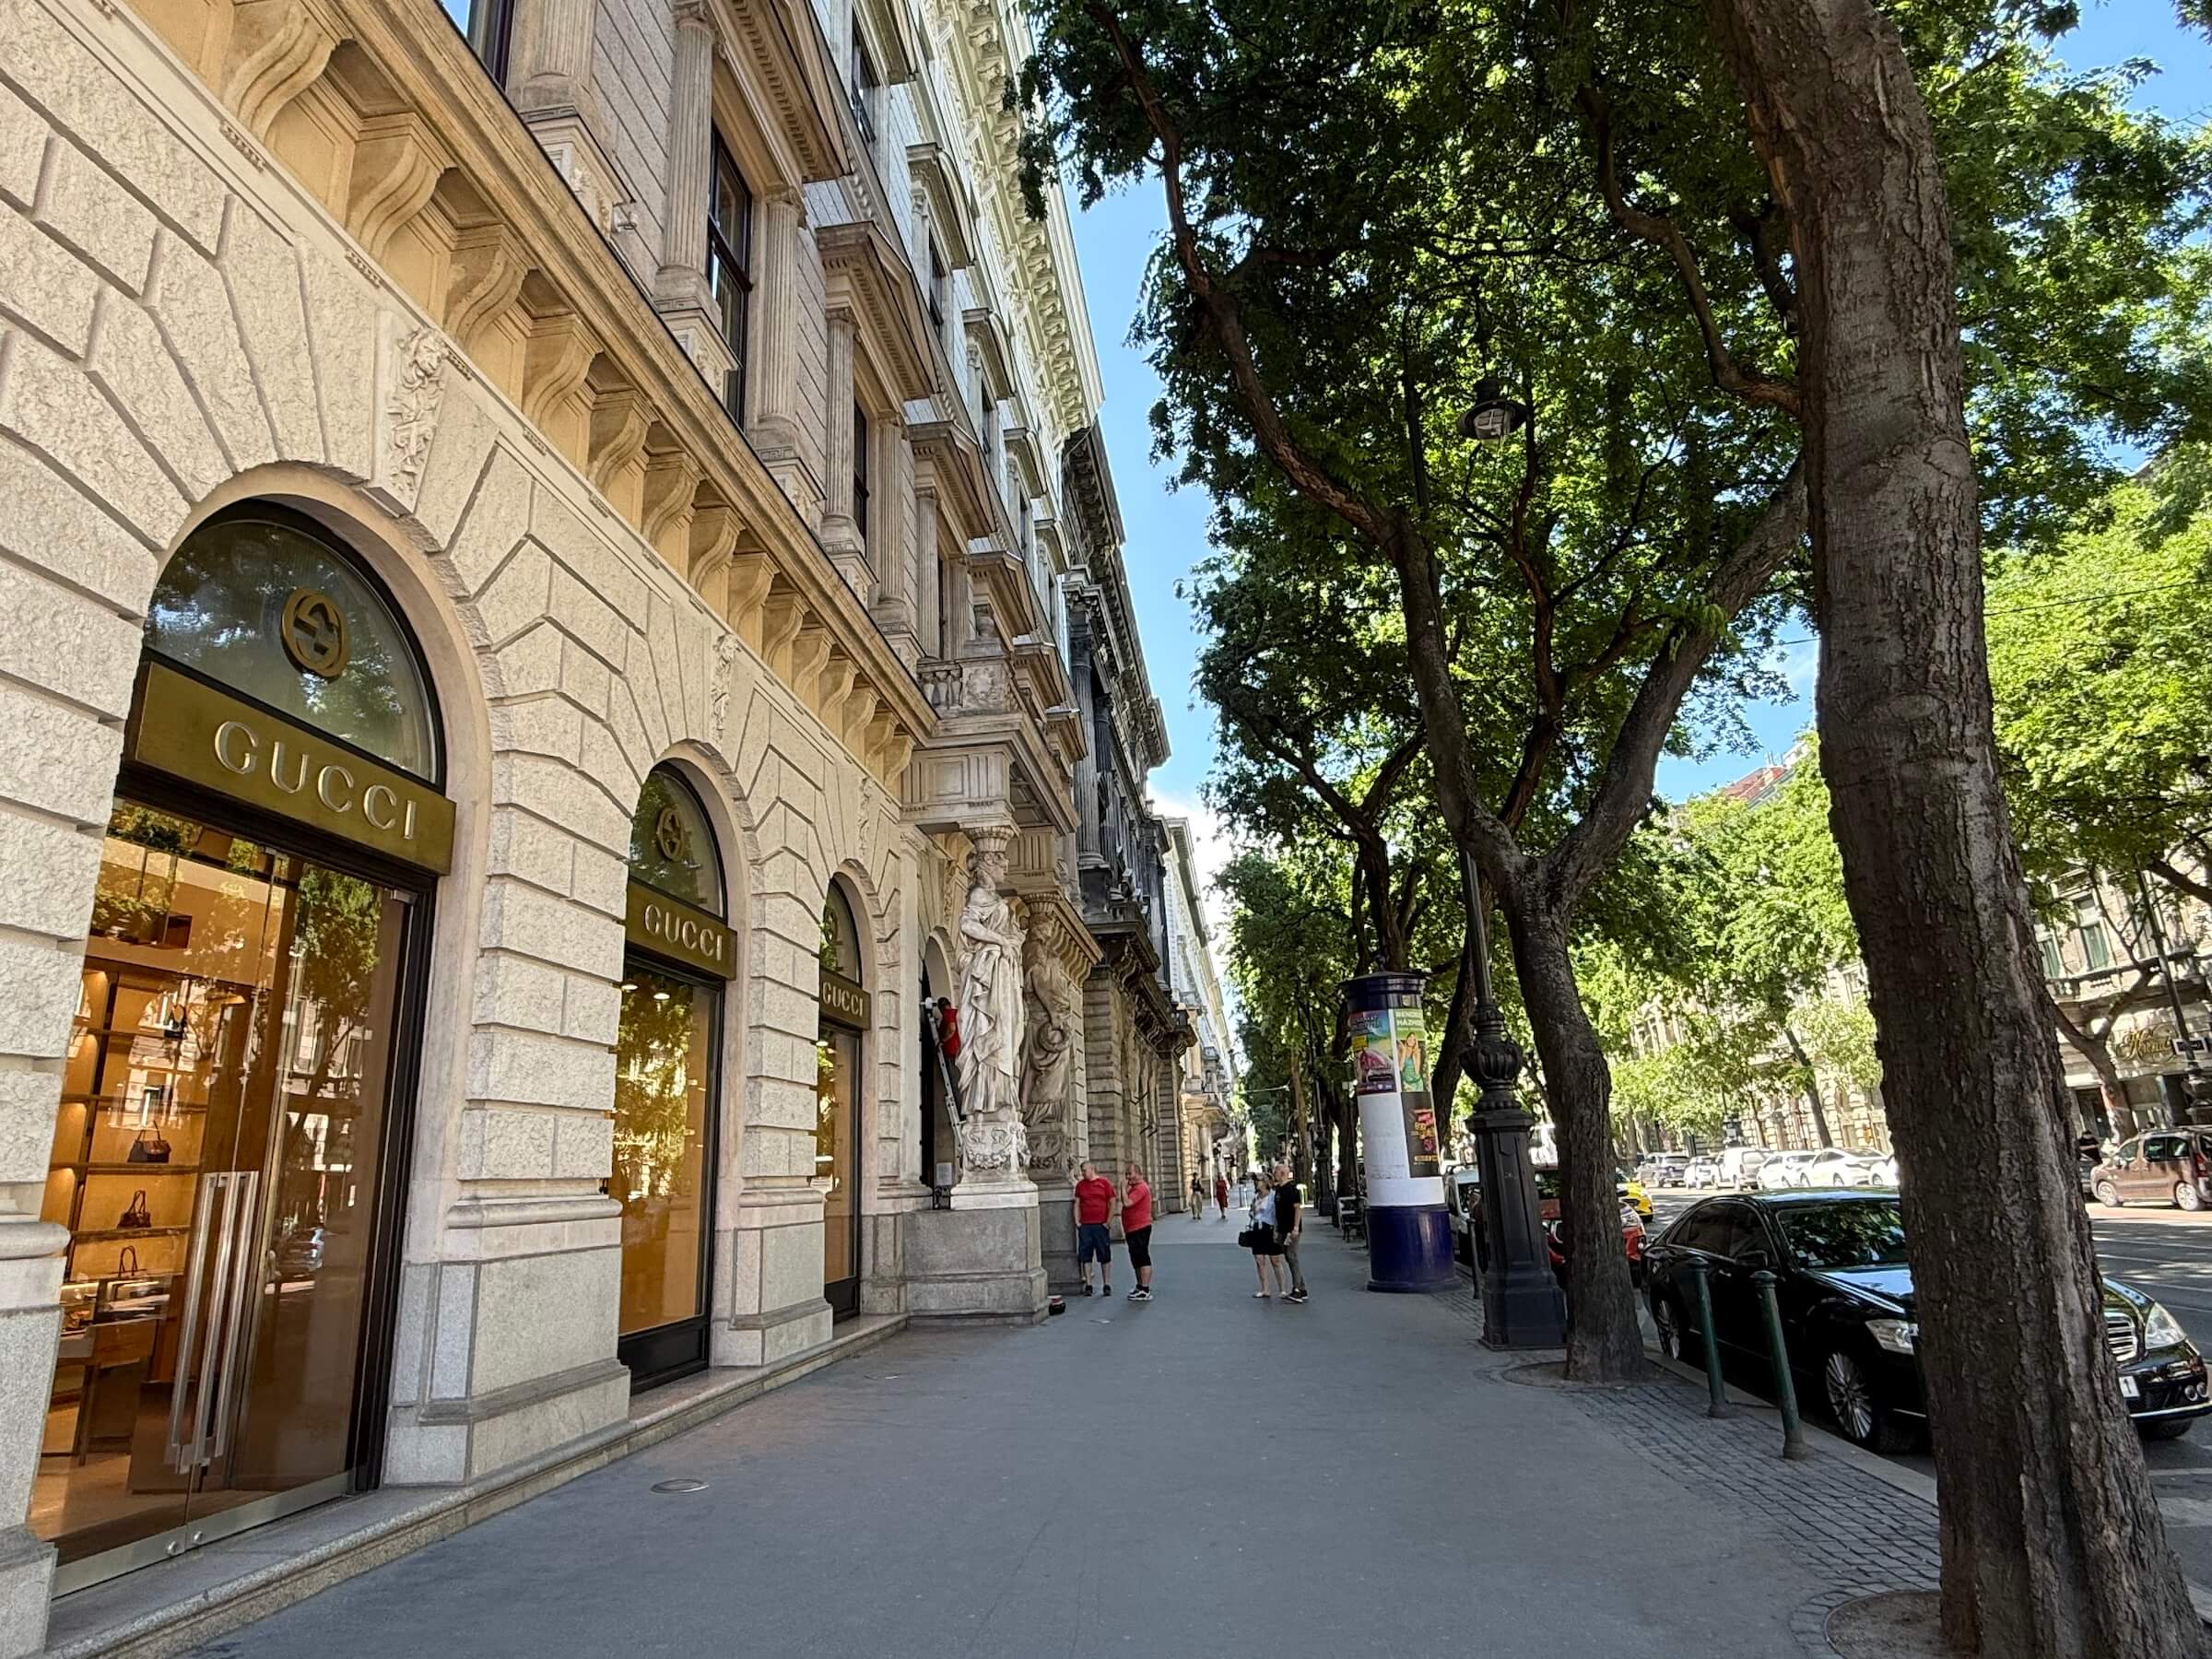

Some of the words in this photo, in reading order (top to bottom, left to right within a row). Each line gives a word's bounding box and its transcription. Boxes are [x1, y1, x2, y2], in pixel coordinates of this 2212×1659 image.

[214, 721, 417, 841] GUCCI
[644, 904, 724, 960] GUCCI
[822, 982, 864, 1017] GUCCI
